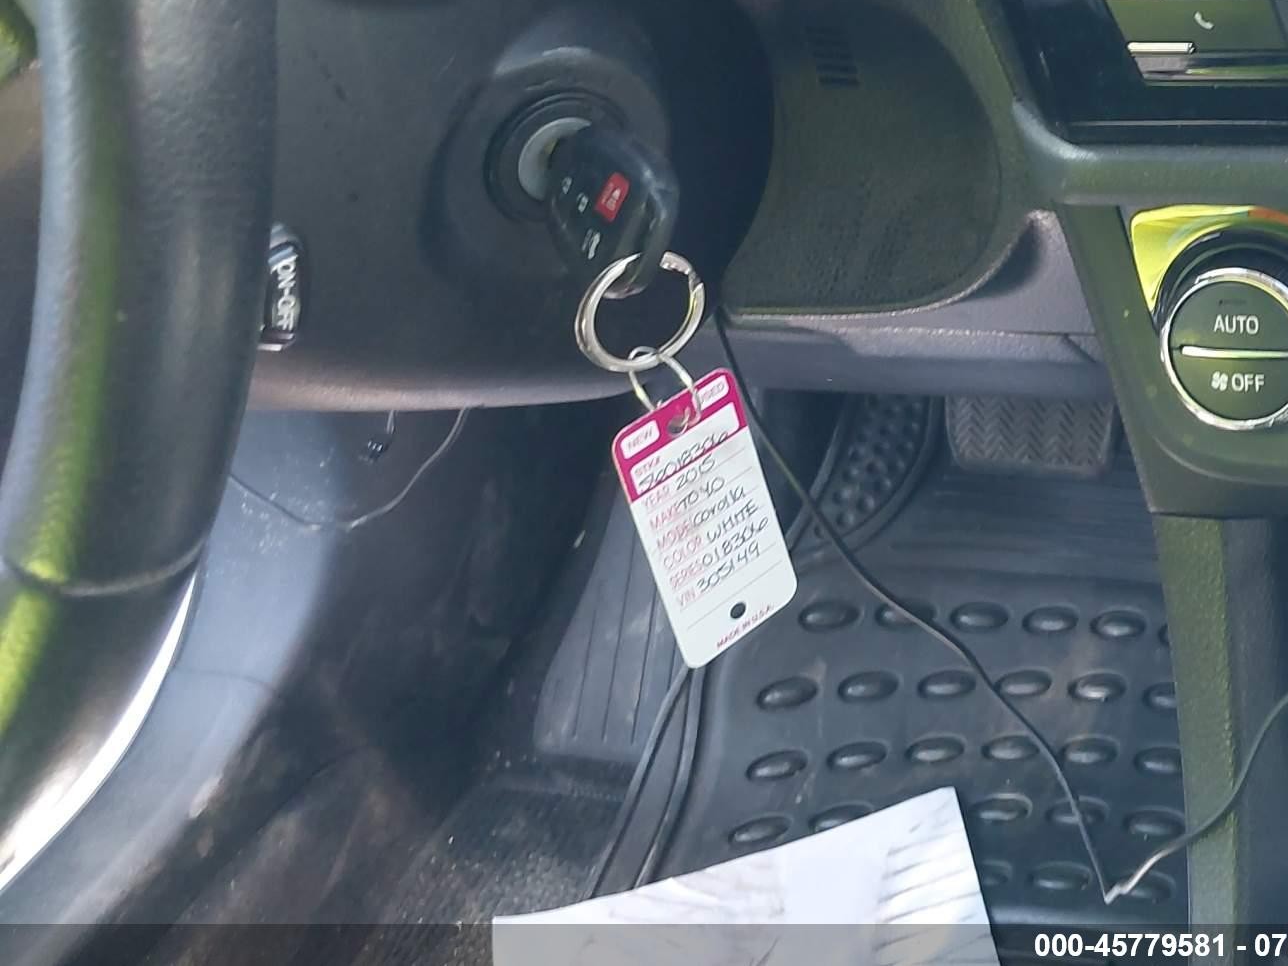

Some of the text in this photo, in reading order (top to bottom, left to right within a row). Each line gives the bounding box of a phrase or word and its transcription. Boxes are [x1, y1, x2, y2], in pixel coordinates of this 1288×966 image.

[1213, 314, 1259, 335] AUTO
[1231, 372, 1265, 393] OFF
[627, 426, 653, 451] NEW
[706, 498, 759, 544] WHITE
